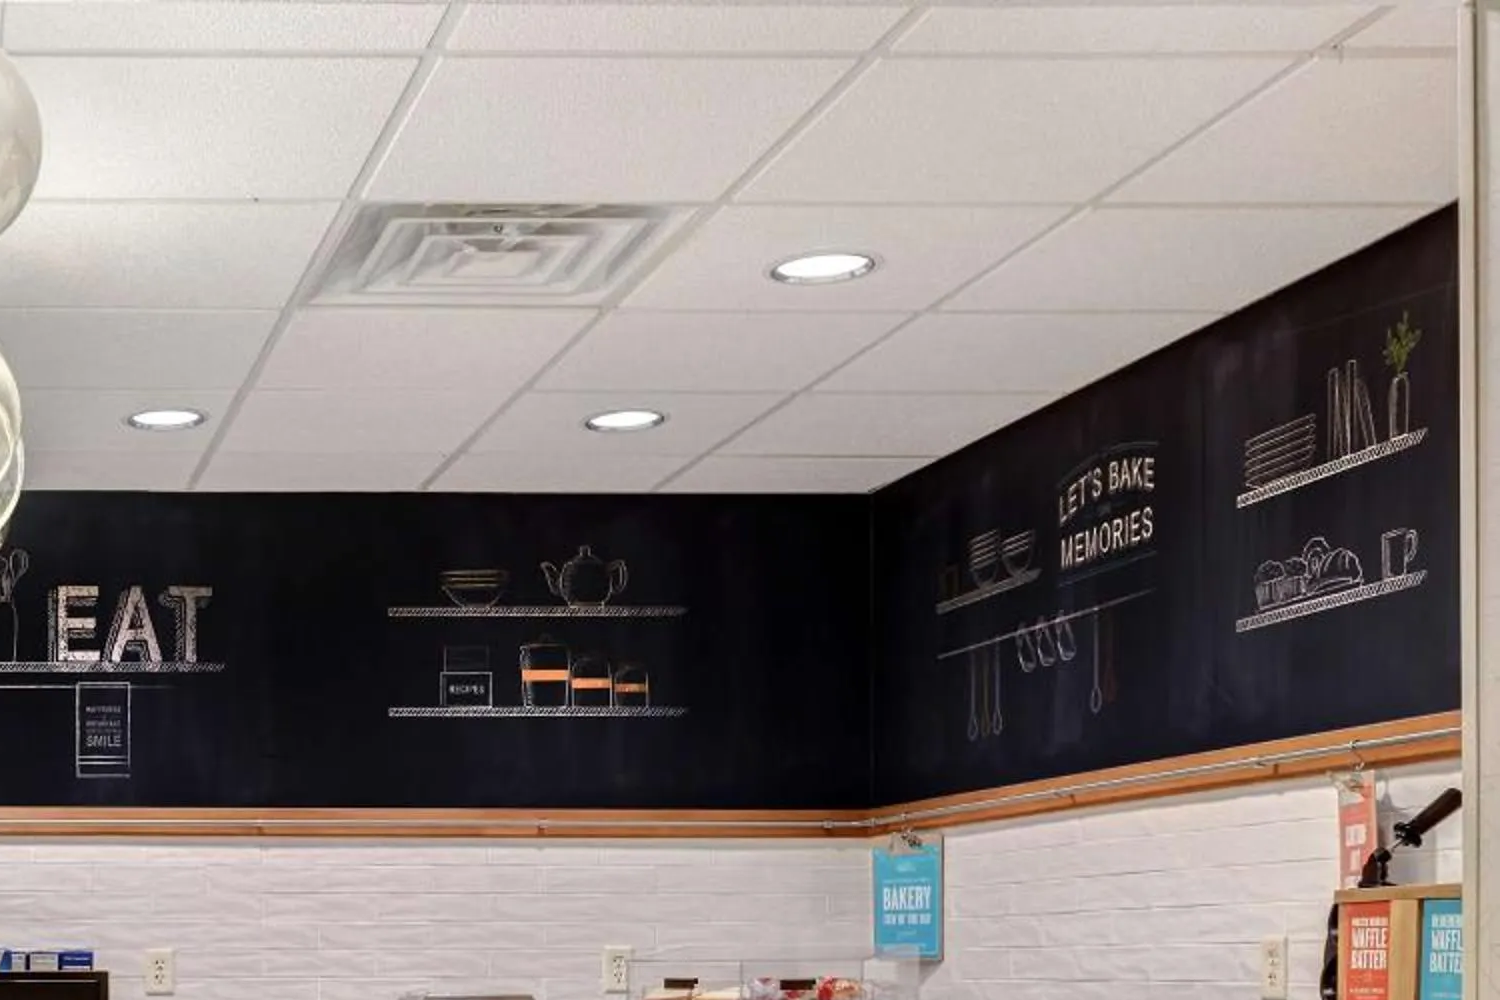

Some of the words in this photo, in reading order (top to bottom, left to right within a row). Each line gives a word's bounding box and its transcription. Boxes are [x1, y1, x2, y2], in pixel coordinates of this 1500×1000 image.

[1060, 467, 1103, 525] LET'S
[1108, 457, 1155, 493] BAKE
[1060, 506, 1154, 569] MEMORIES
[49, 584, 214, 668] EAT
[86, 735, 123, 748] SMILE
[882, 883, 932, 911] BAKERY
[1350, 927, 1388, 949] WAFFLE
[1350, 949, 1388, 970] BATTER
